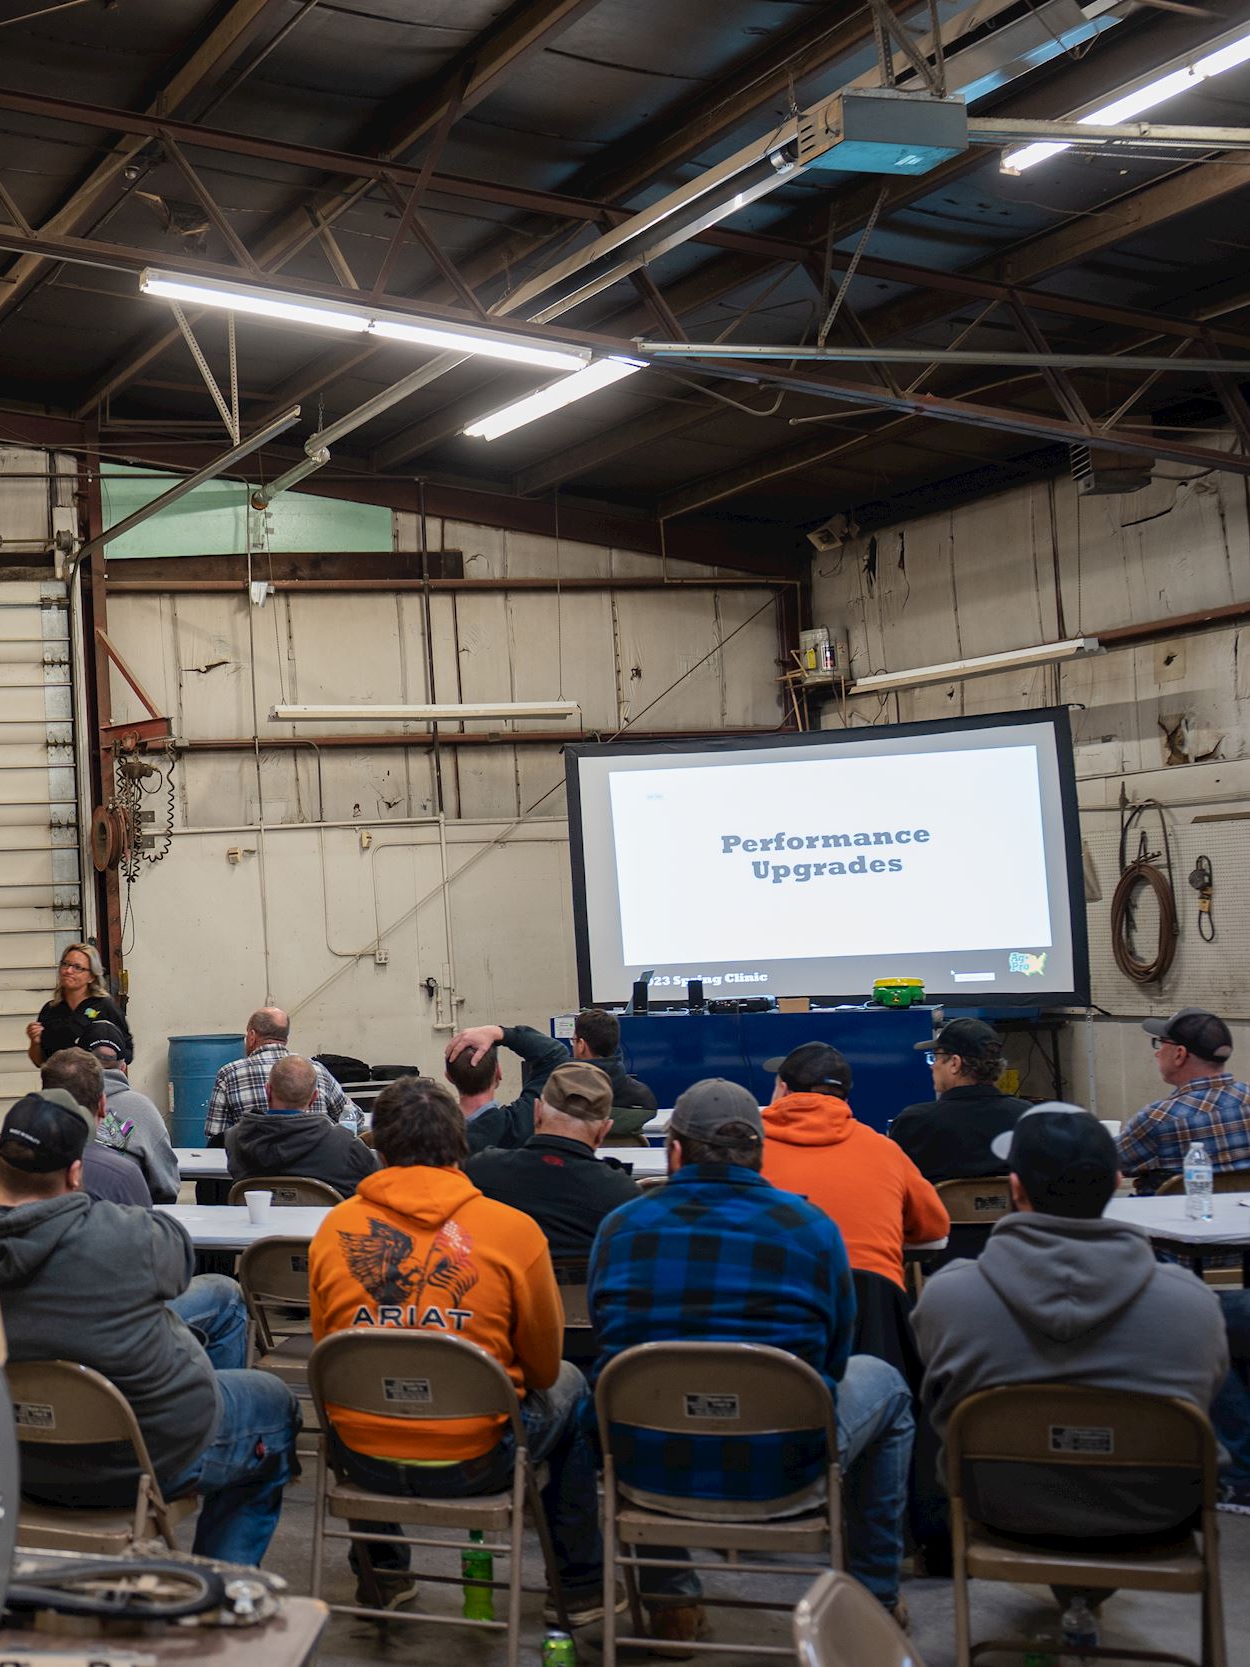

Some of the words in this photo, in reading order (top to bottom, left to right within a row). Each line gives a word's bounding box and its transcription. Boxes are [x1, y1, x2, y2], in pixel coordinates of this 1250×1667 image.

[721, 826, 931, 854] Performance
[751, 855, 903, 884] Upgrades
[638, 975, 671, 987] 23
[724, 972, 769, 984] Clinic
[353, 1305, 472, 1331] ARIAT
